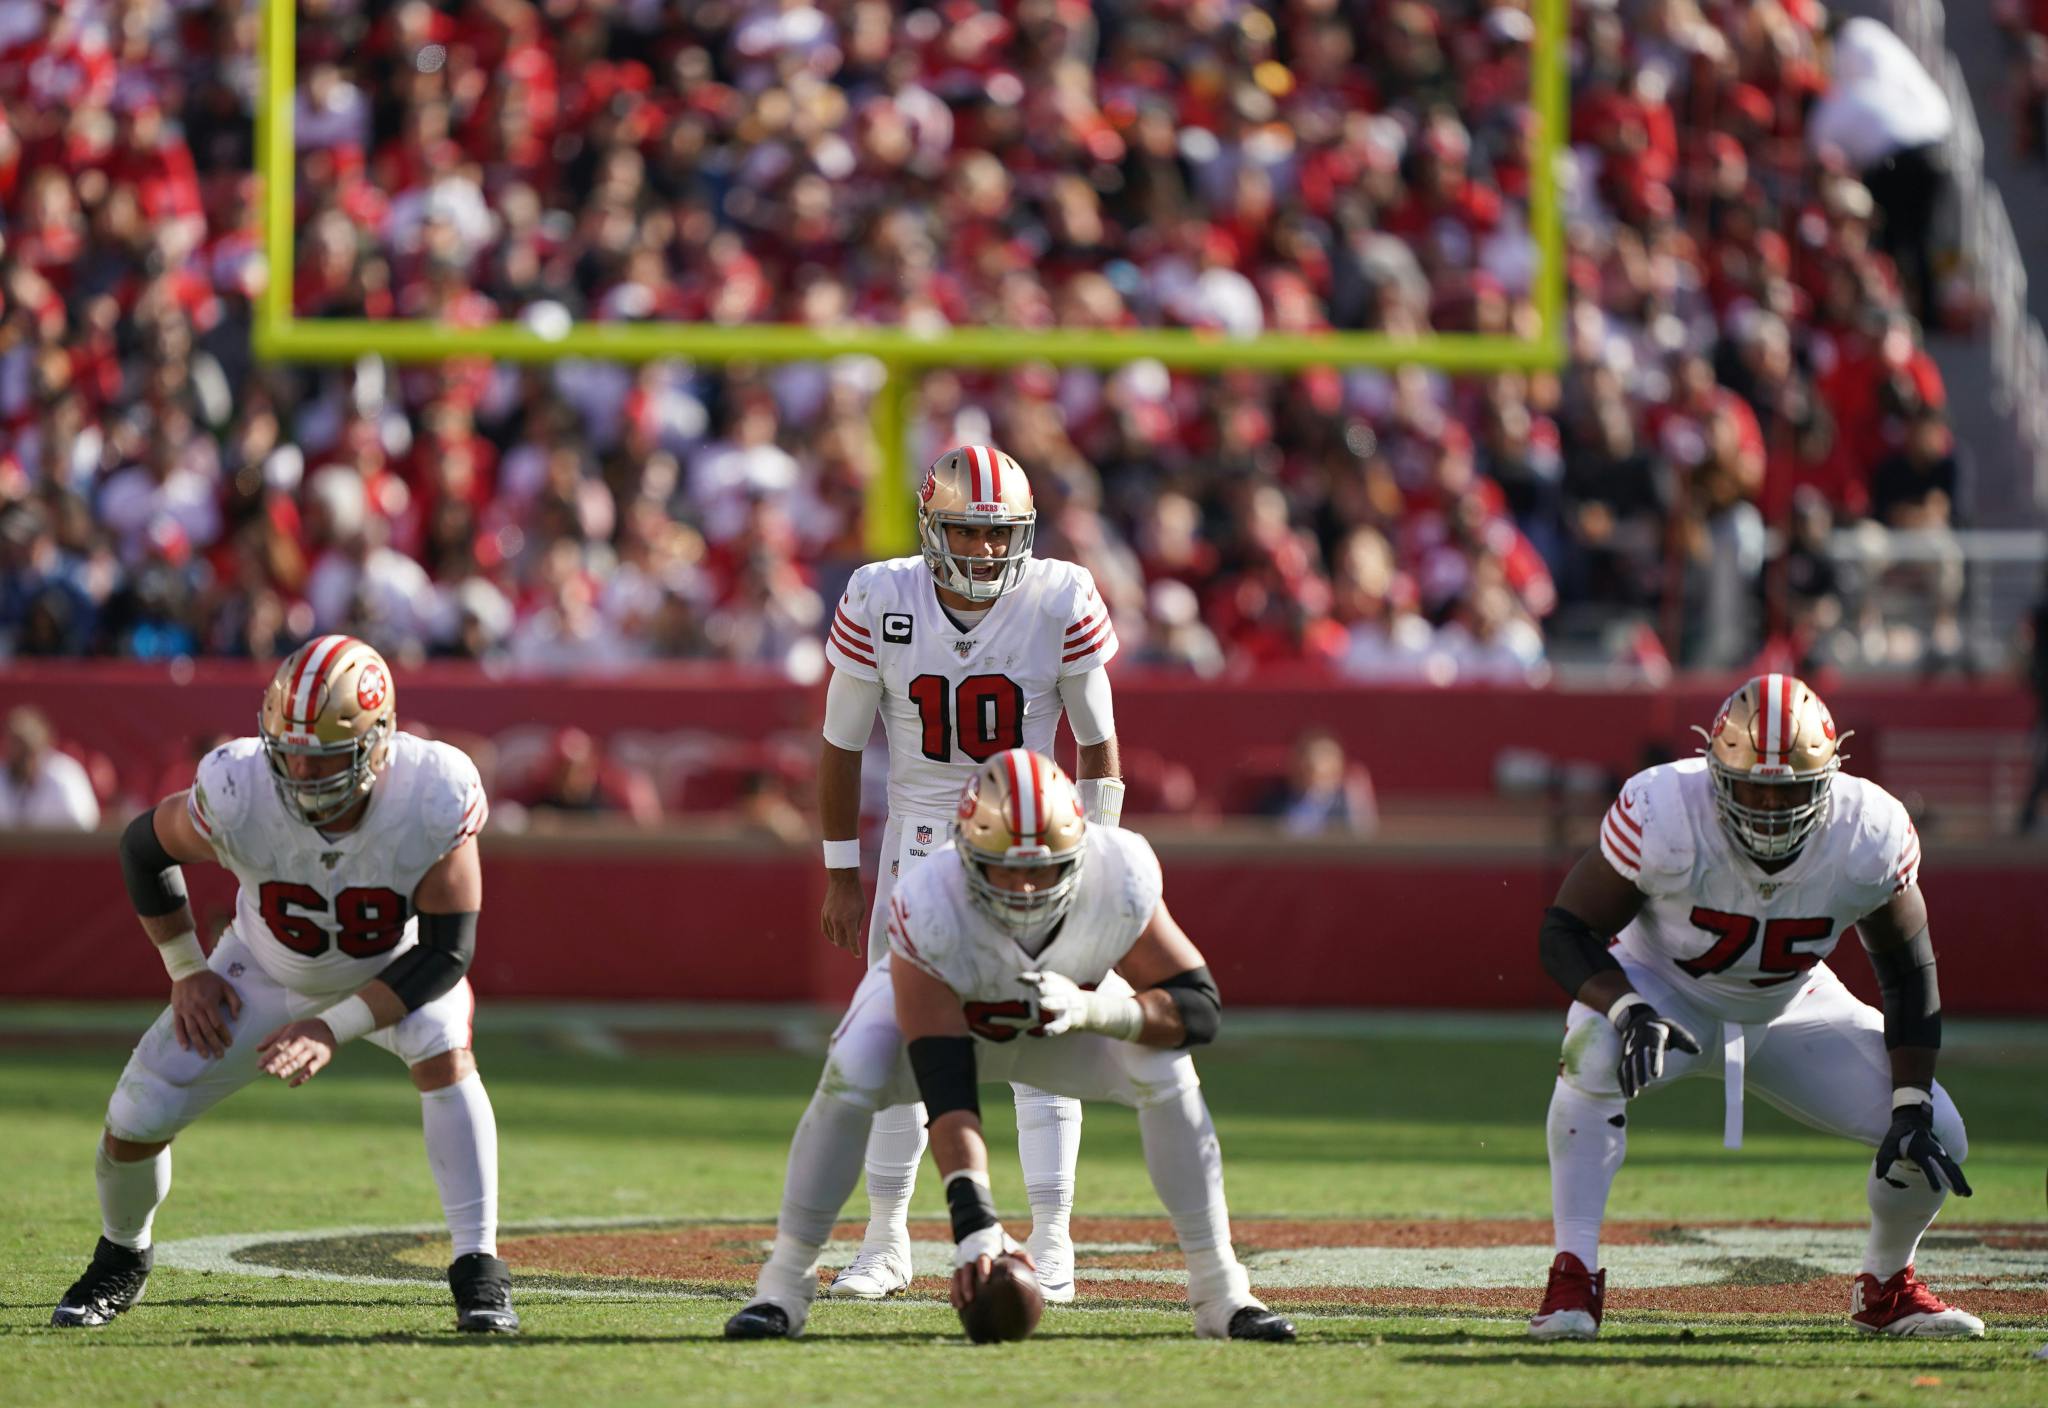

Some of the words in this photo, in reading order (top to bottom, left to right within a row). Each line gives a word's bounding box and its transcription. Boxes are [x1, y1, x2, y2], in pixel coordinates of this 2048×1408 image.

[976, 504, 998, 512] 49ERS
[885, 615, 910, 637] C
[909, 674, 1024, 764] 10
[259, 881, 407, 959] 68
[1673, 906, 1834, 988] 75
[963, 988, 1085, 1042] 5
